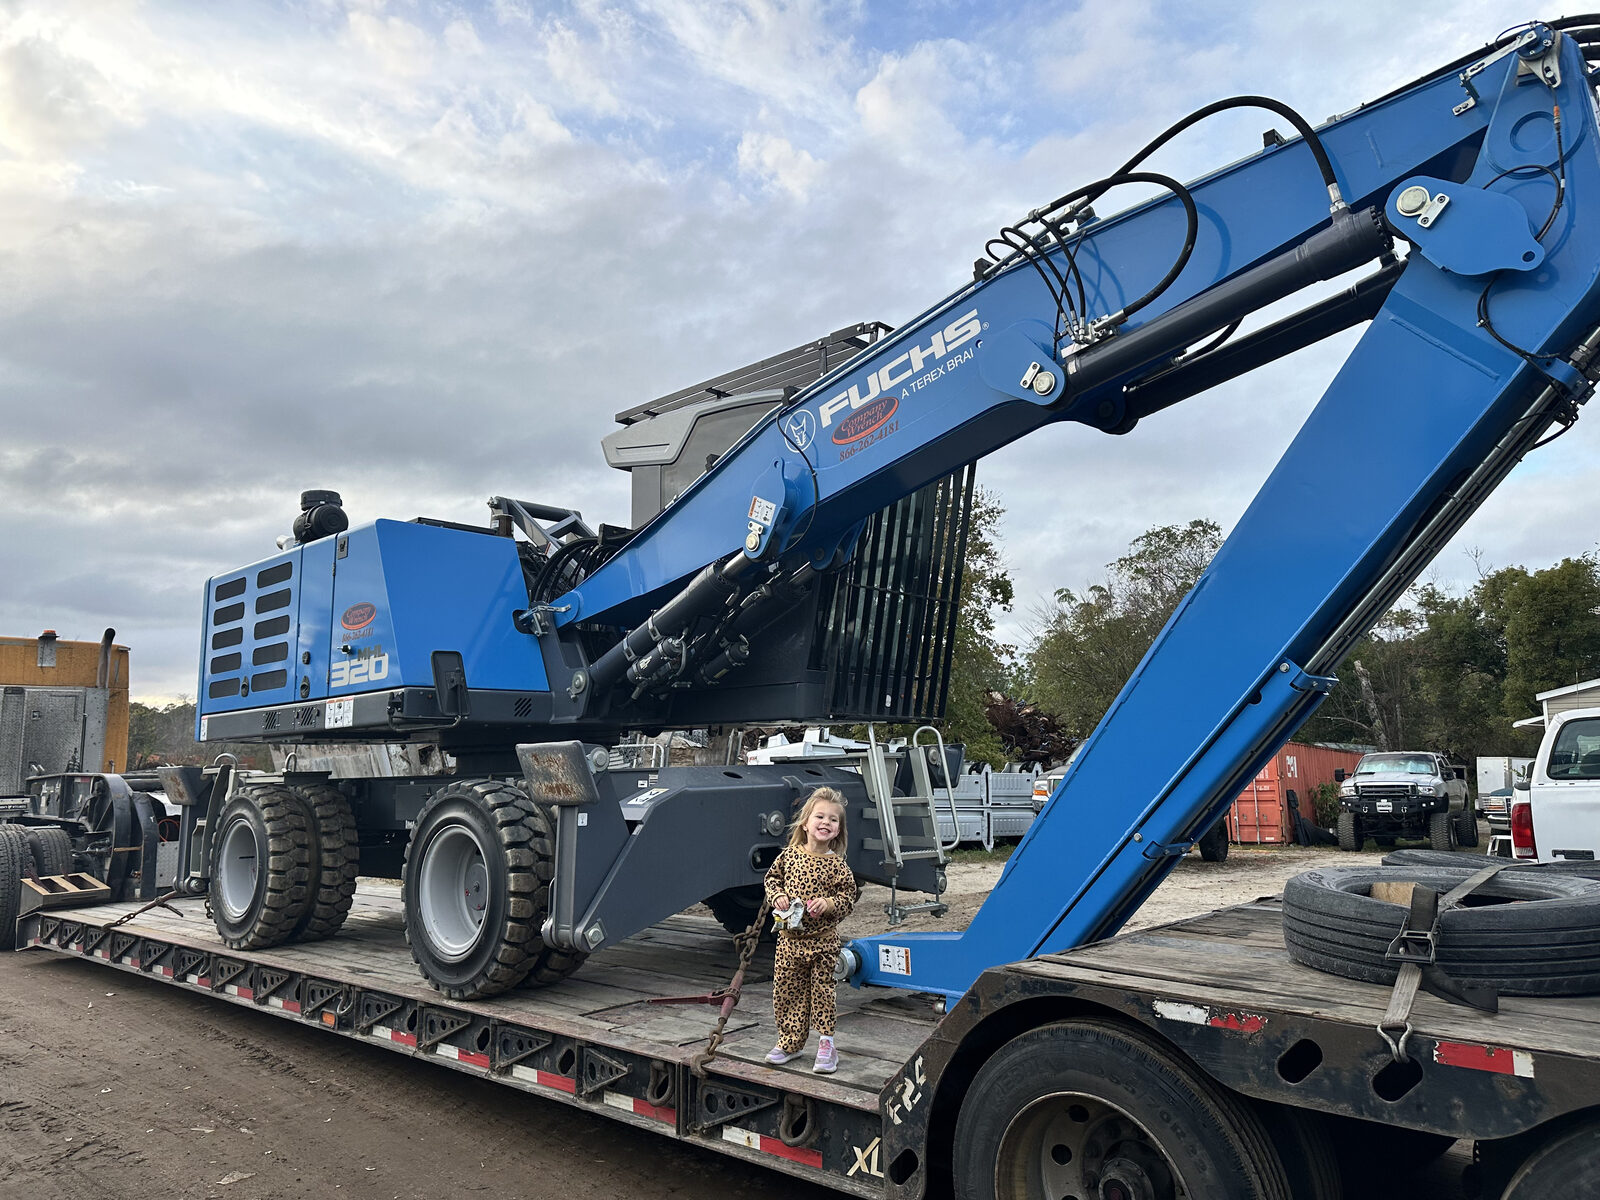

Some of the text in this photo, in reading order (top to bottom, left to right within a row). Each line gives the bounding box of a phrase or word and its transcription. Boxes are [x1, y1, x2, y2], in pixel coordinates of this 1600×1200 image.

[901, 388, 910, 399] A
[909, 364, 946, 394] TEREX
[841, 400, 888, 432] Company
[848, 410, 883, 437] Wrench
[840, 419, 899, 462] 866-262-4181
[331, 652, 389, 688] 320
[357, 644, 386, 662] MHL
[846, 1136, 885, 1178] XL
